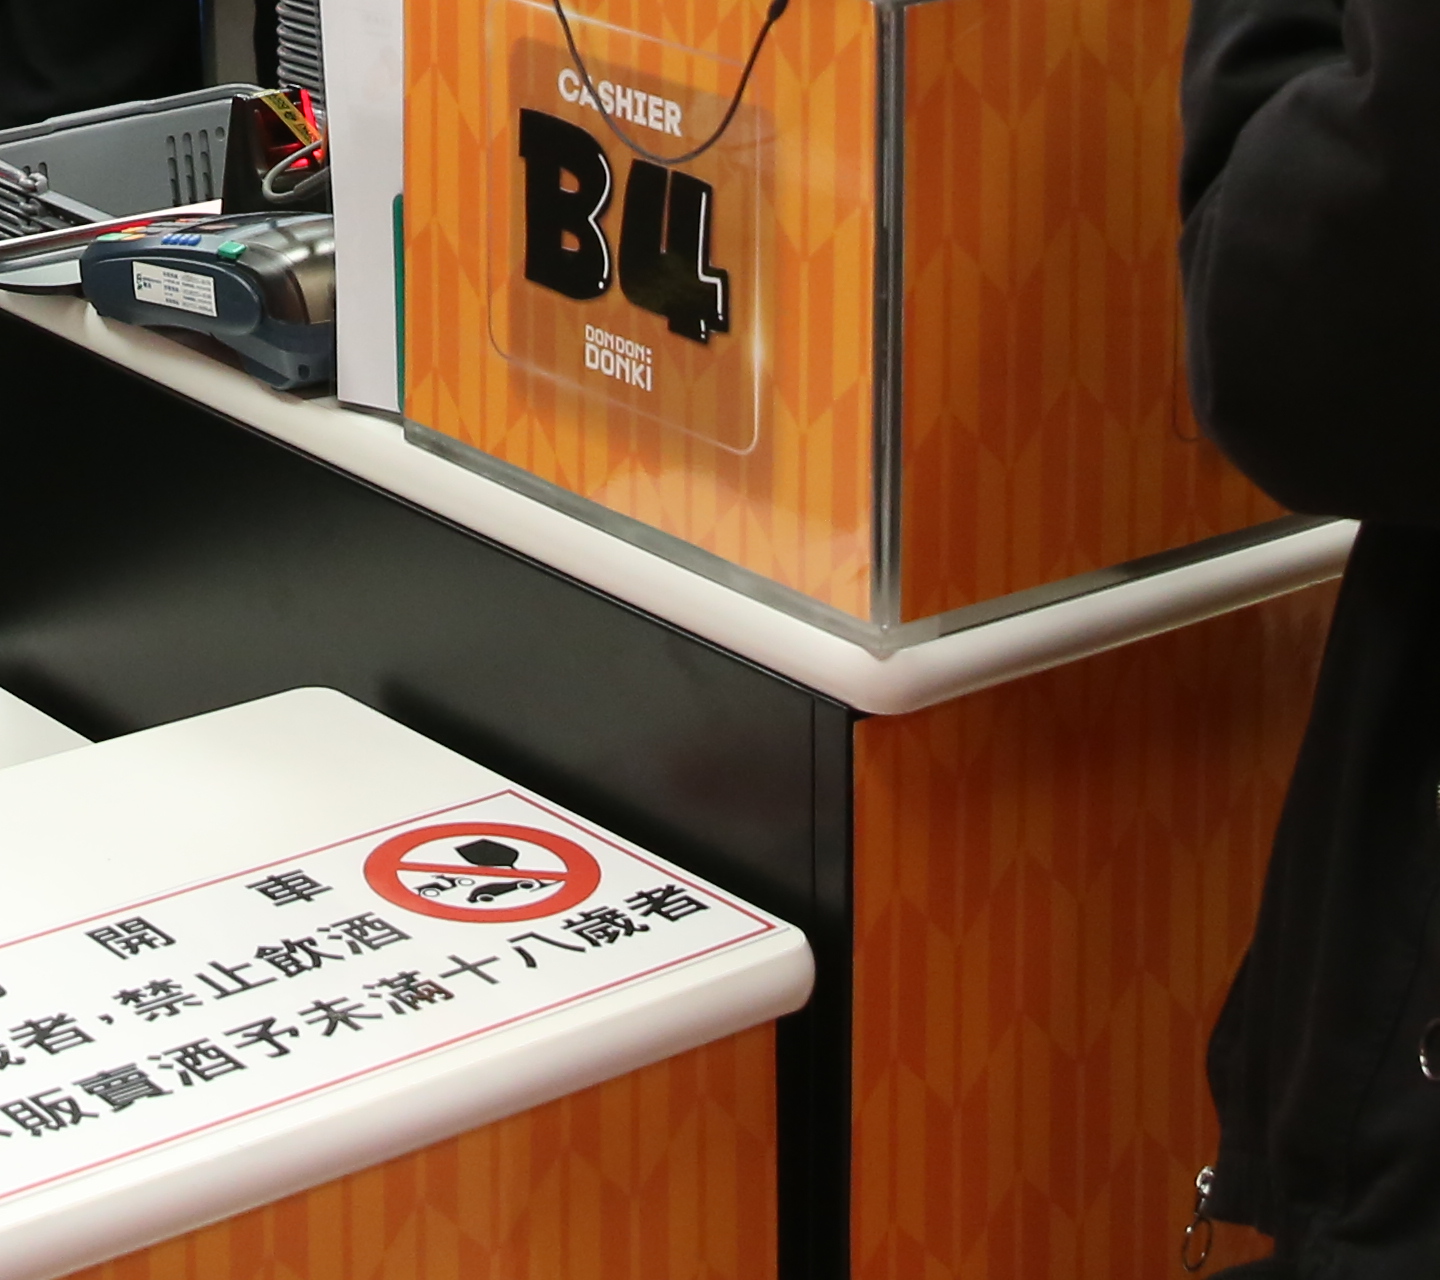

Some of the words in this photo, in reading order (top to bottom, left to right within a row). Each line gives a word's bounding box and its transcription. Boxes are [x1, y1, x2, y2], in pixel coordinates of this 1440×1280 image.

[556, 68, 684, 138] CASHIER
[519, 107, 730, 345] B4
[585, 341, 653, 393] DONKI
